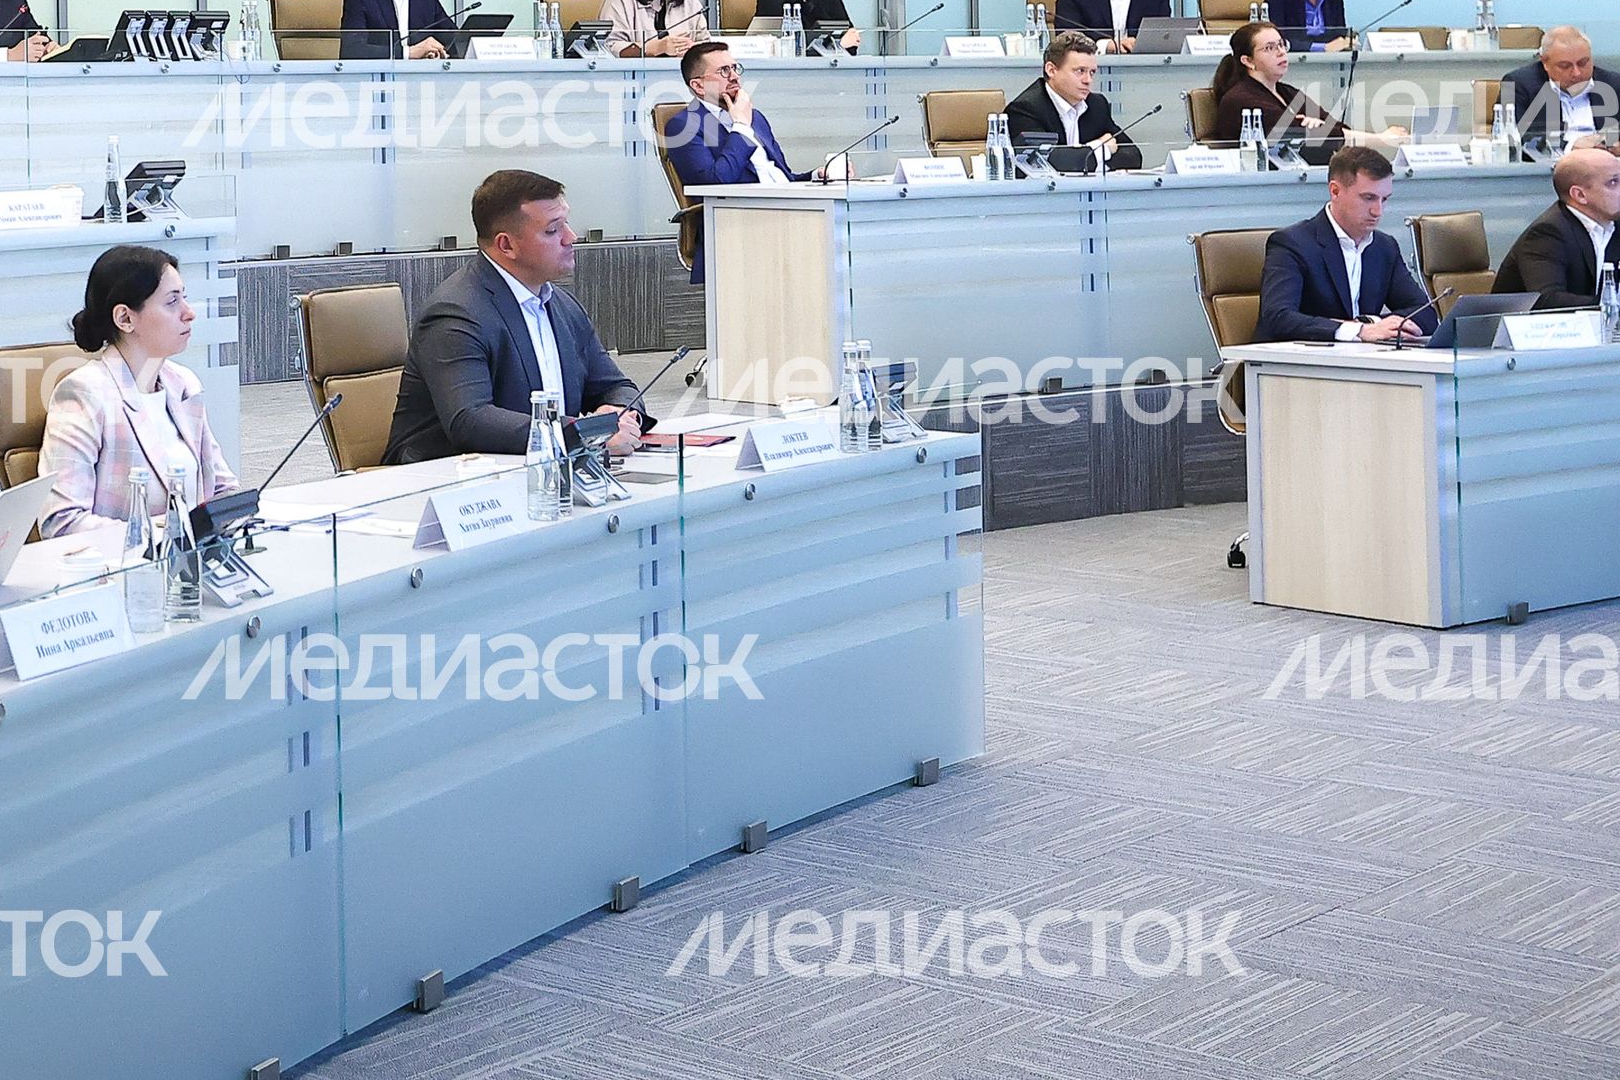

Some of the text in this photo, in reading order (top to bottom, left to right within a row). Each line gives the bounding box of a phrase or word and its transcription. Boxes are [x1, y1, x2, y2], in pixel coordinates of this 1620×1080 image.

[781, 431, 809, 445] ЛОКТЕВ
[459, 498, 502, 517] ОКУДЖАВА
[40, 609, 99, 635] ФЕДОТОВА
[35, 628, 116, 660] Нина Аркадьевна
